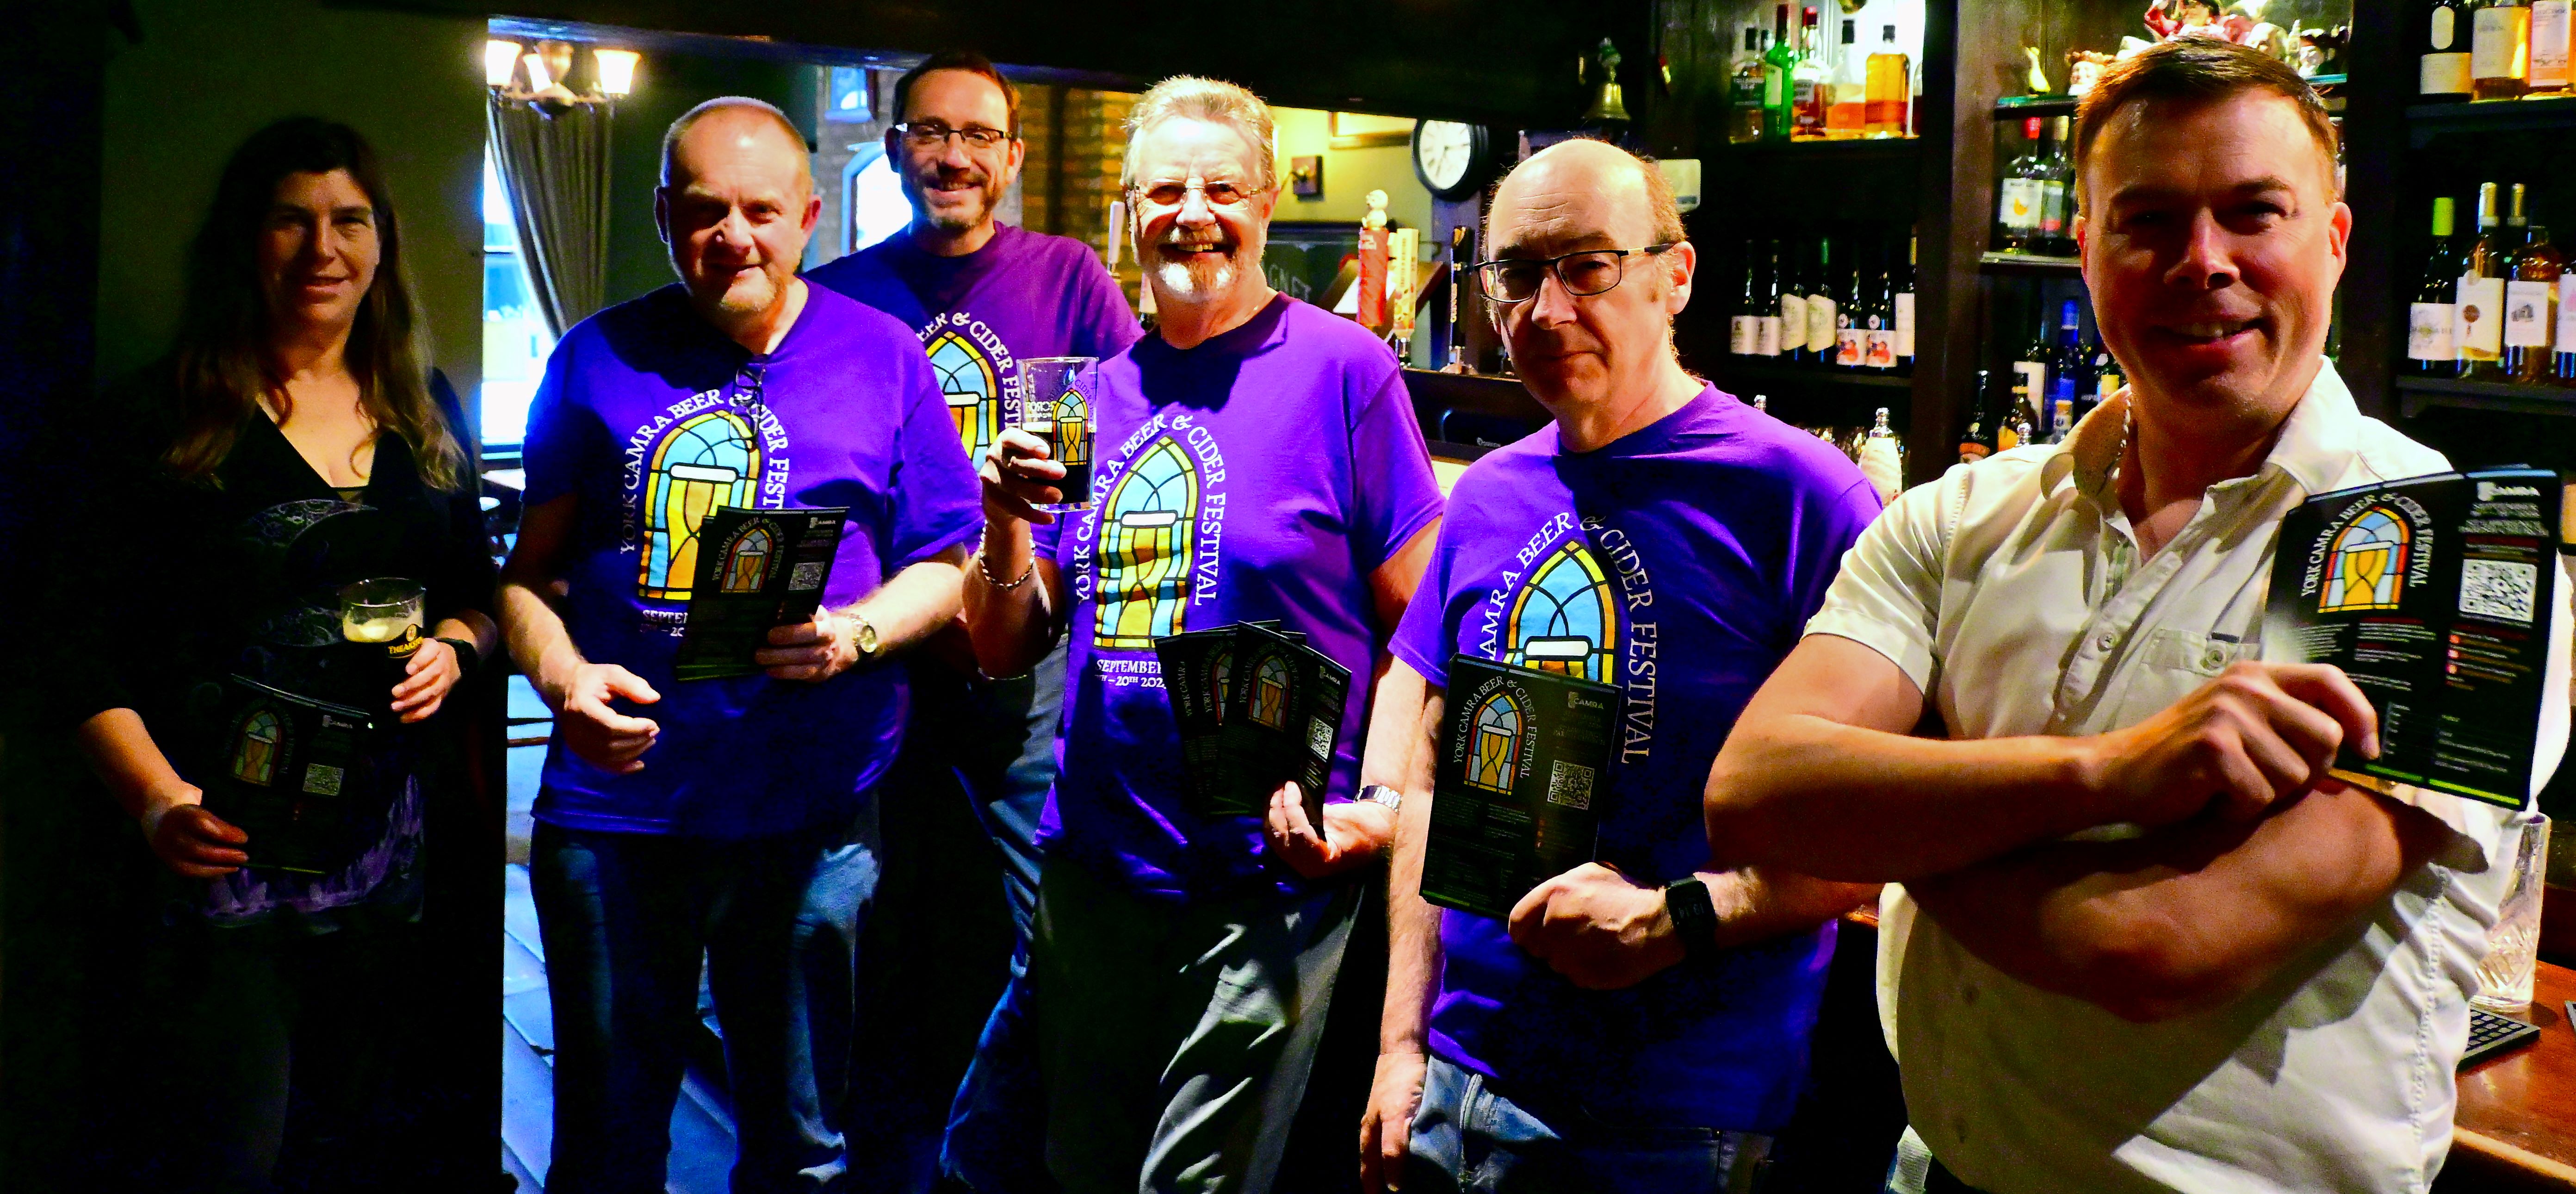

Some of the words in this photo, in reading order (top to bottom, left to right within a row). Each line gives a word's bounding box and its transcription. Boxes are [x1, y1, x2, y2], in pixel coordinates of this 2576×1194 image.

[916, 313, 948, 342] EER
[952, 312, 971, 326] &
[970, 321, 1014, 373] CIDER
[1002, 375, 1022, 429] FESTI
[667, 389, 725, 420] BEER
[1172, 415, 1194, 430] &
[625, 416, 674, 490] CAMRA
[1119, 414, 1167, 459] BEER
[1187, 426, 1226, 489] CIDER
[763, 457, 789, 509] FEST
[1077, 459, 1125, 542] CAMRA
[620, 494, 637, 554] YORK
[1194, 492, 1226, 606] FESTIVAL
[1516, 511, 1573, 569] BEER
[1579, 516, 1606, 532] &
[1074, 544, 1090, 605] YORK
[1599, 529, 1653, 612] CIDER
[2300, 564, 2322, 597] YORK
[1480, 570, 1522, 661] AMRA
[1140, 677, 1167, 690] 202
[1479, 676, 1504, 696] BEER
[1506, 679, 1517, 688] &
[1515, 688, 1536, 722] CIDER
[1573, 697, 1604, 710] CAMRA
[1621, 621, 1658, 765] FESTIVAL
[1459, 693, 1482, 733] CAMRA
[1453, 733, 1467, 763] YORK
[1519, 725, 1538, 778] FESTIVAL
